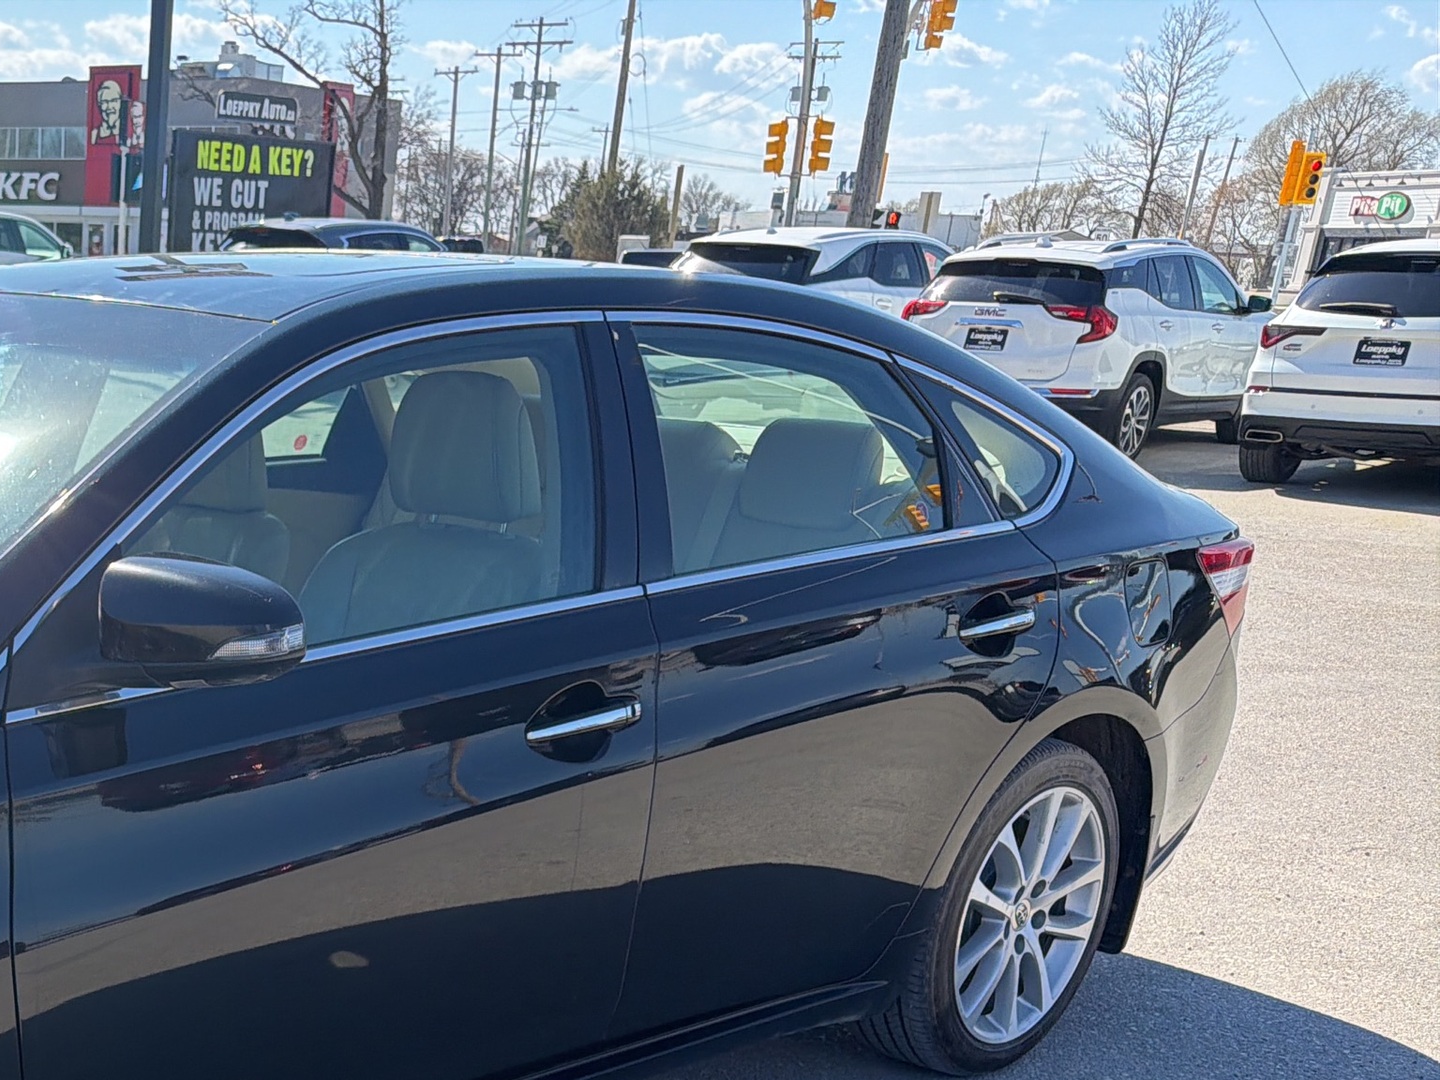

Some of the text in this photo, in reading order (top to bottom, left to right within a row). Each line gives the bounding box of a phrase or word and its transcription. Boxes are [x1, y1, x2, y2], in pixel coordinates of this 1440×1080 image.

[197, 140, 314, 177] NEED A KEY?
[193, 176, 269, 209] WE CUT
[1350, 196, 1402, 215] Pita Pit
[192, 210, 201, 230] &
[974, 307, 1007, 317] GMC
[1361, 344, 1405, 355] Loeppky
